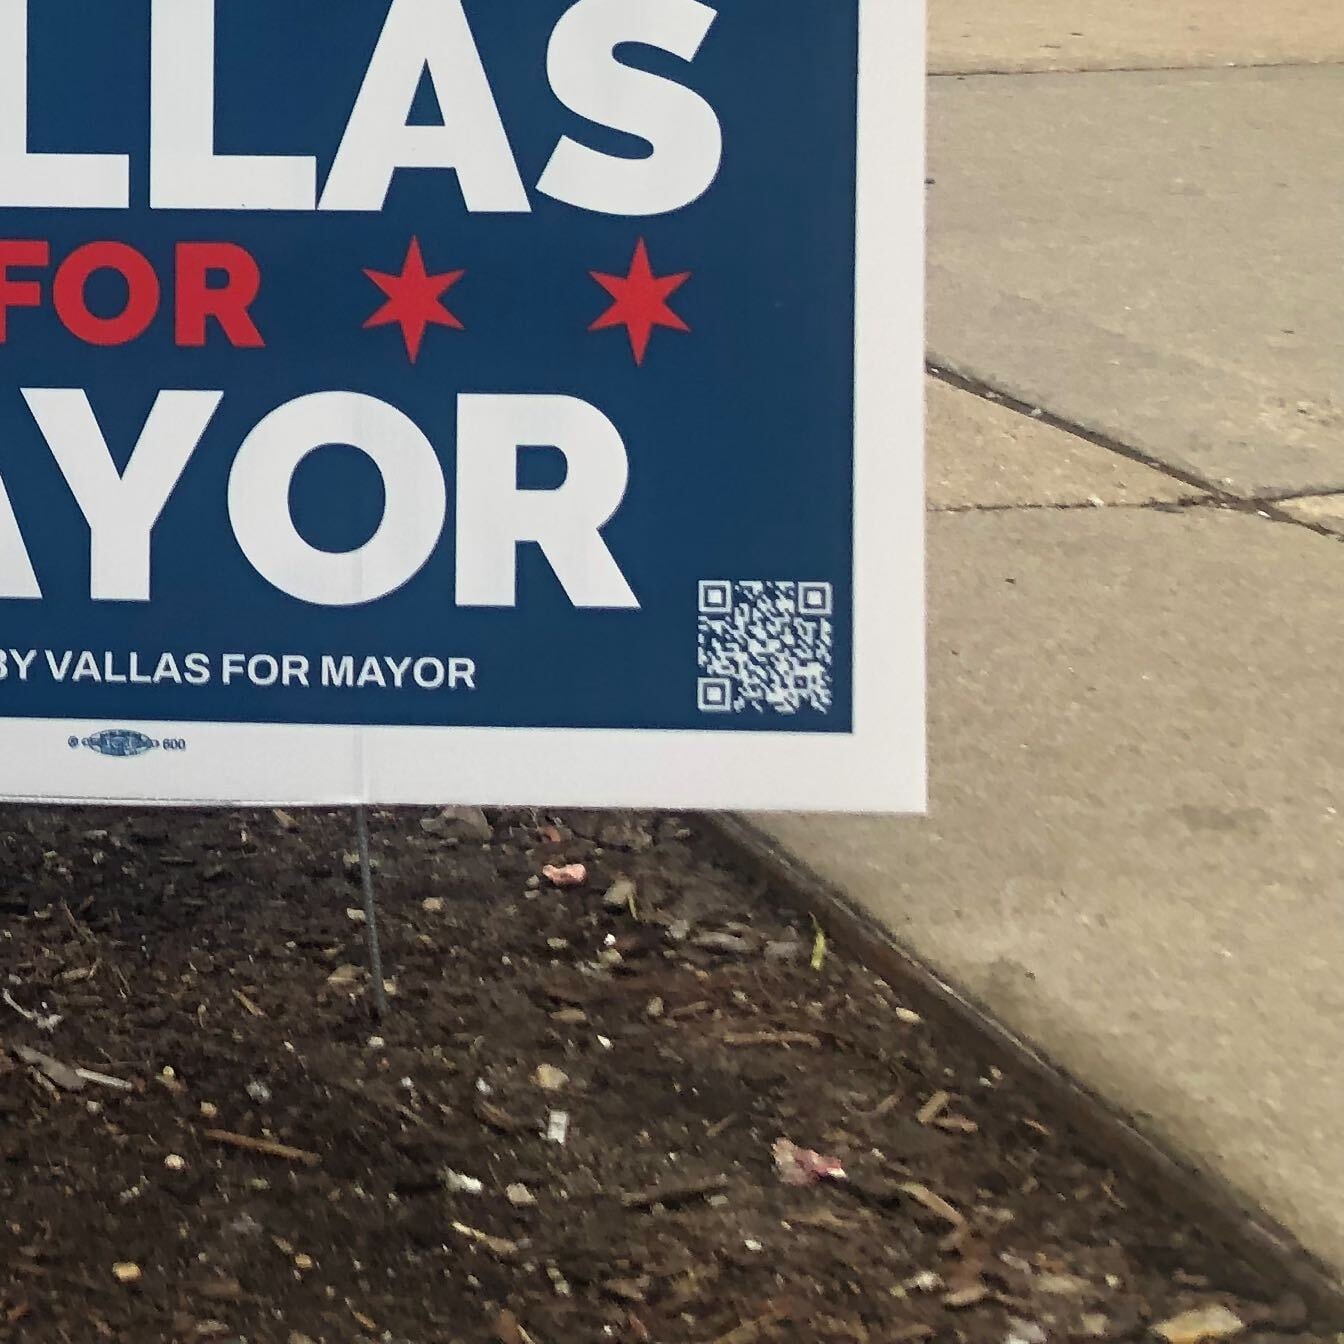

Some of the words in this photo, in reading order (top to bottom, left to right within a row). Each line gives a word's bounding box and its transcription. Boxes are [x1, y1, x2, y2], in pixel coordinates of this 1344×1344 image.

[44, 650, 210, 684] VALLAS
[222, 653, 309, 686] FOR
[321, 655, 476, 689] MAYOR
[162, 738, 186, 751] 600
